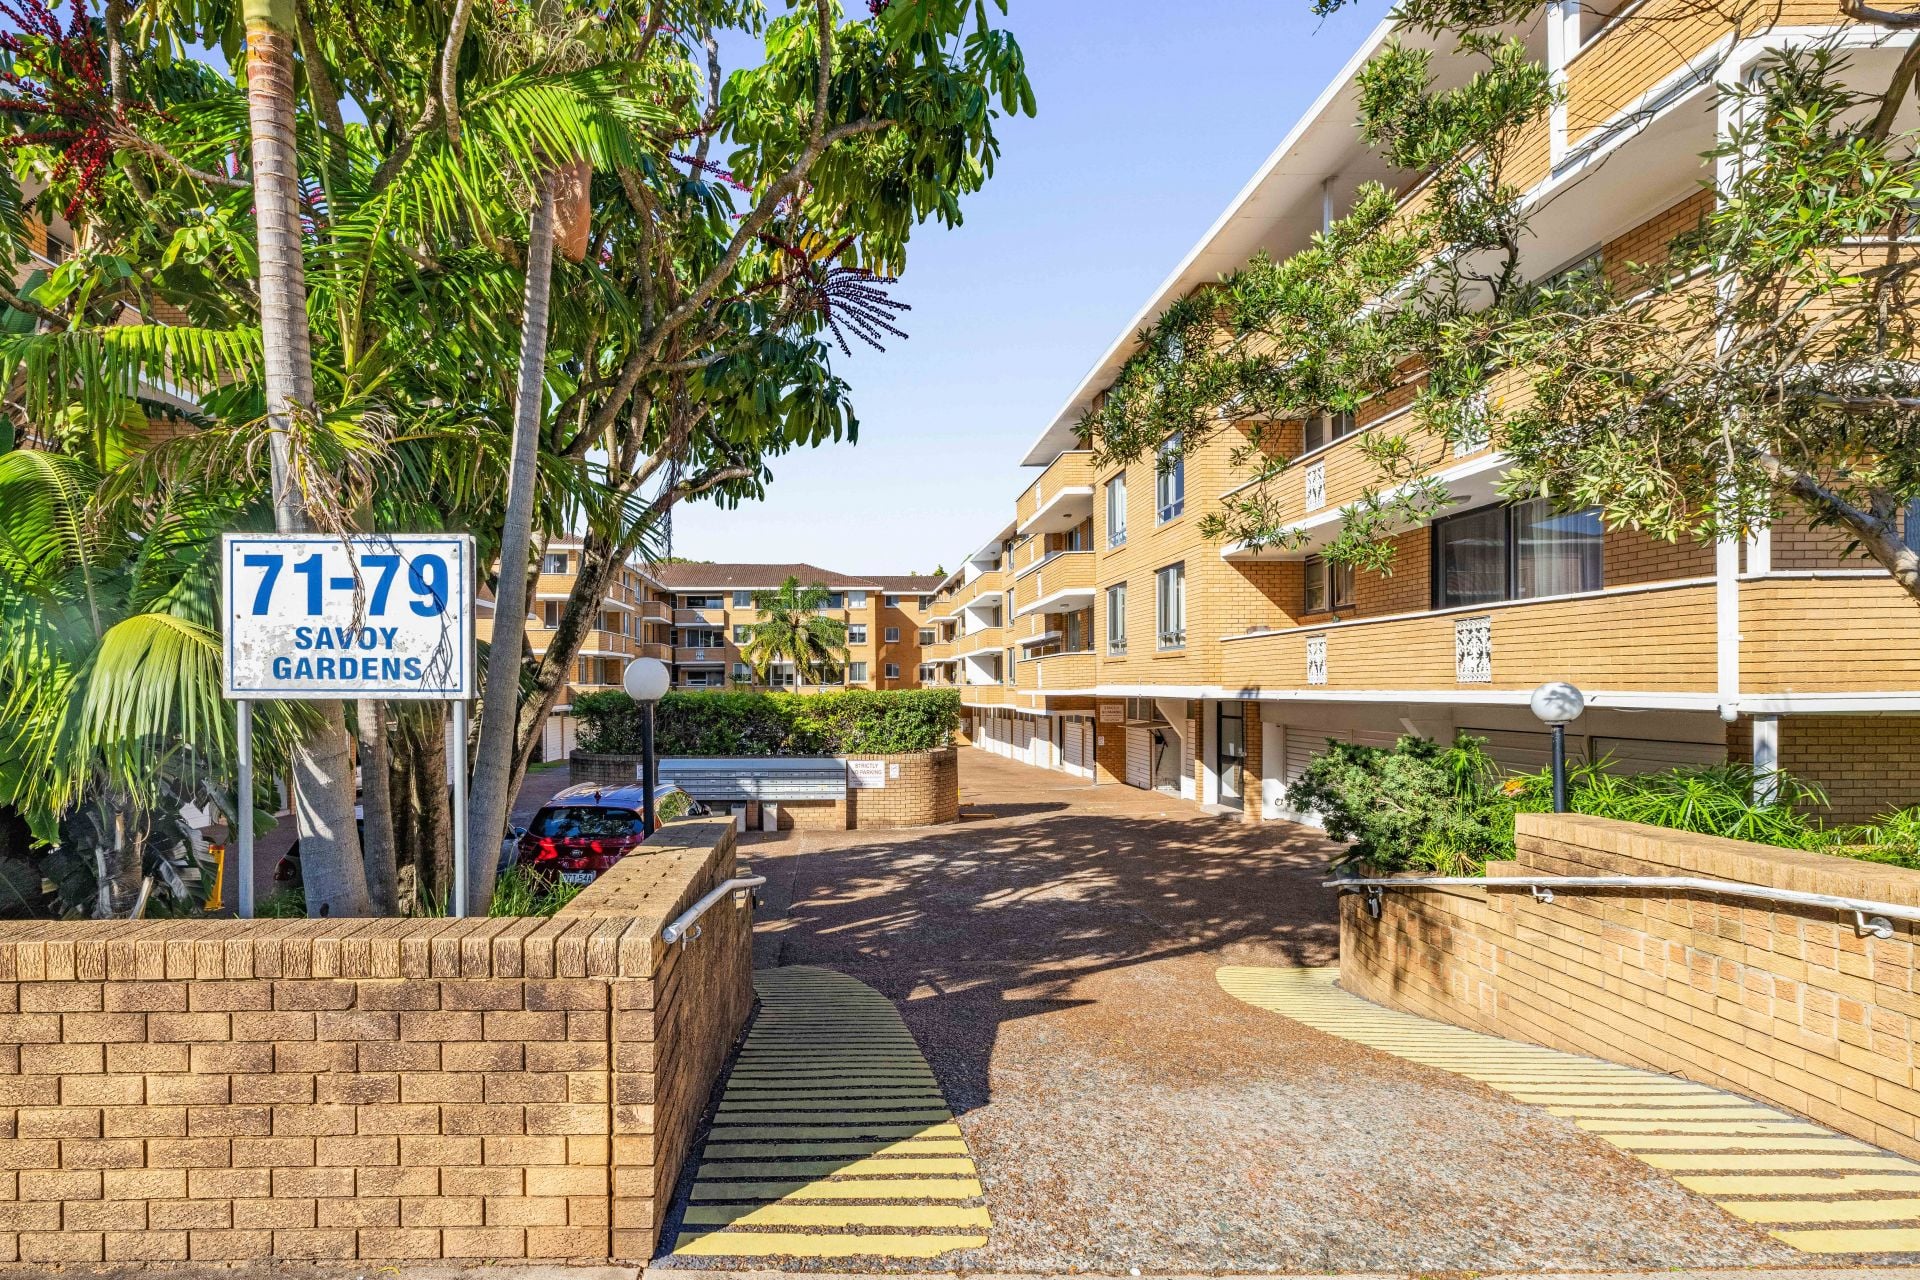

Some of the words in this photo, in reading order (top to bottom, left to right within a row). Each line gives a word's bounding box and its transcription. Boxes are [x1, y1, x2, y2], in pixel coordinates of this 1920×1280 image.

[244, 553, 448, 617] 71-79
[295, 626, 398, 650] SAVOY
[273, 656, 422, 681] GARDENS
